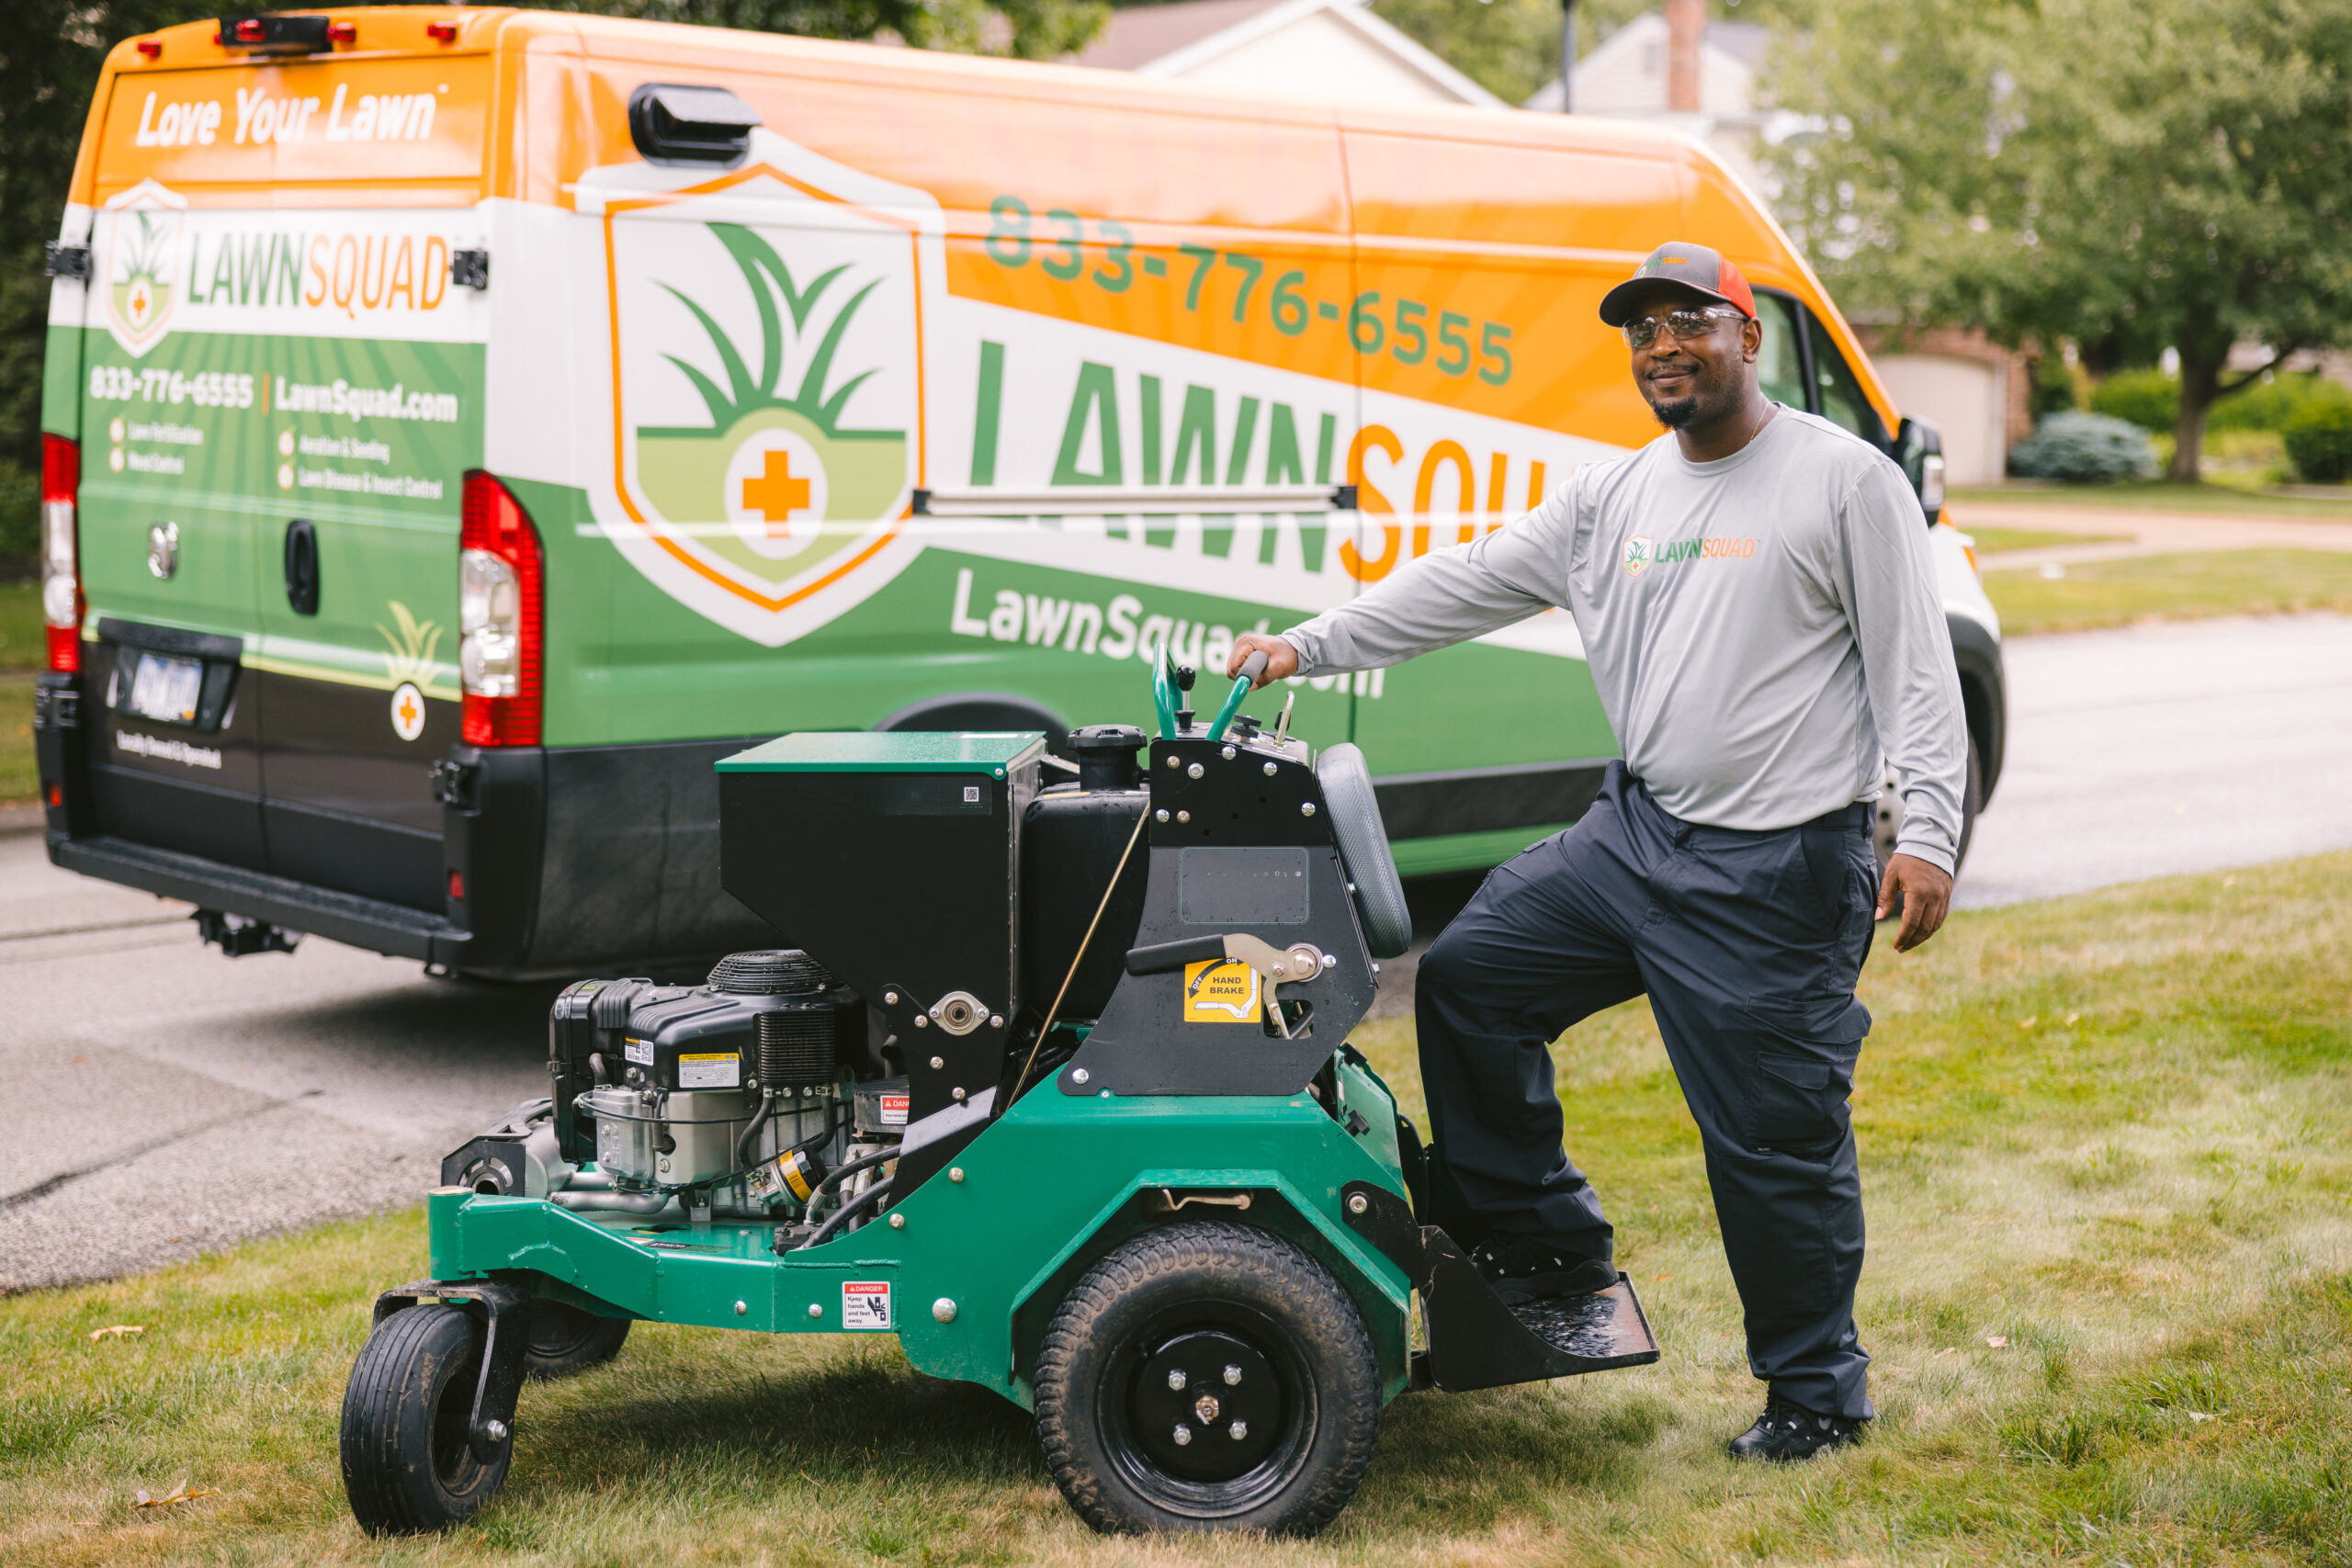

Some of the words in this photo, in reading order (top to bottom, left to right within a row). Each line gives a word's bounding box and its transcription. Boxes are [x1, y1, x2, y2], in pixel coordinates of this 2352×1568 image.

[136, 91, 221, 146] Love
[233, 86, 320, 144] Your
[325, 83, 436, 141] Lawn
[187, 231, 448, 320] LAWNSQUAD
[984, 195, 1514, 387] 833-776-6555
[90, 365, 254, 410] 833-776-6555
[275, 375, 458, 423] LawnSquad.com
[1655, 537, 1756, 564] LAWNSQUAD
[1192, 976, 1204, 989] OFF
[1209, 987, 1244, 995] BRAKE
